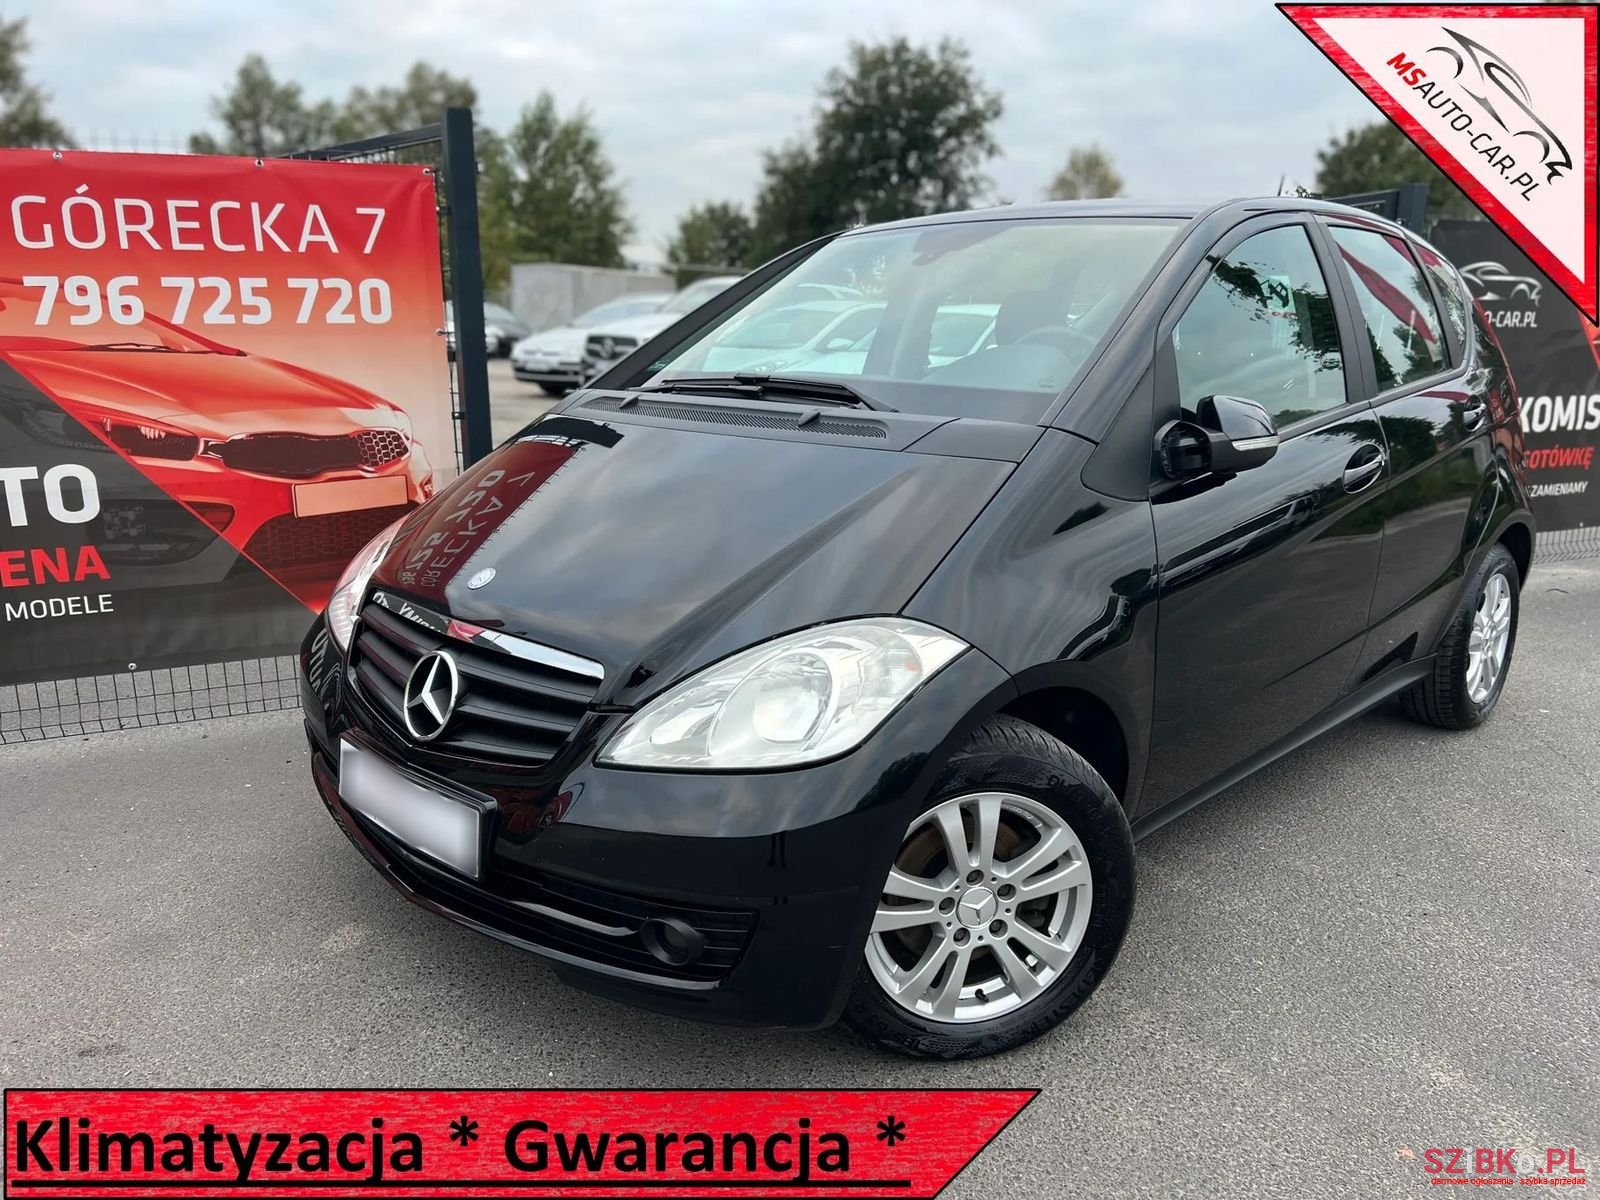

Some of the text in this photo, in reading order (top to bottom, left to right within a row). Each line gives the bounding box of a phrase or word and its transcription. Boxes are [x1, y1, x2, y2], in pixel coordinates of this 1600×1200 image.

[12, 184, 386, 254] GÓRECKA 7
[22, 276, 393, 326] 796 725 720
[1530, 481, 1589, 498] ZAMIENIAMY
[5, 594, 114, 622] MODELE
